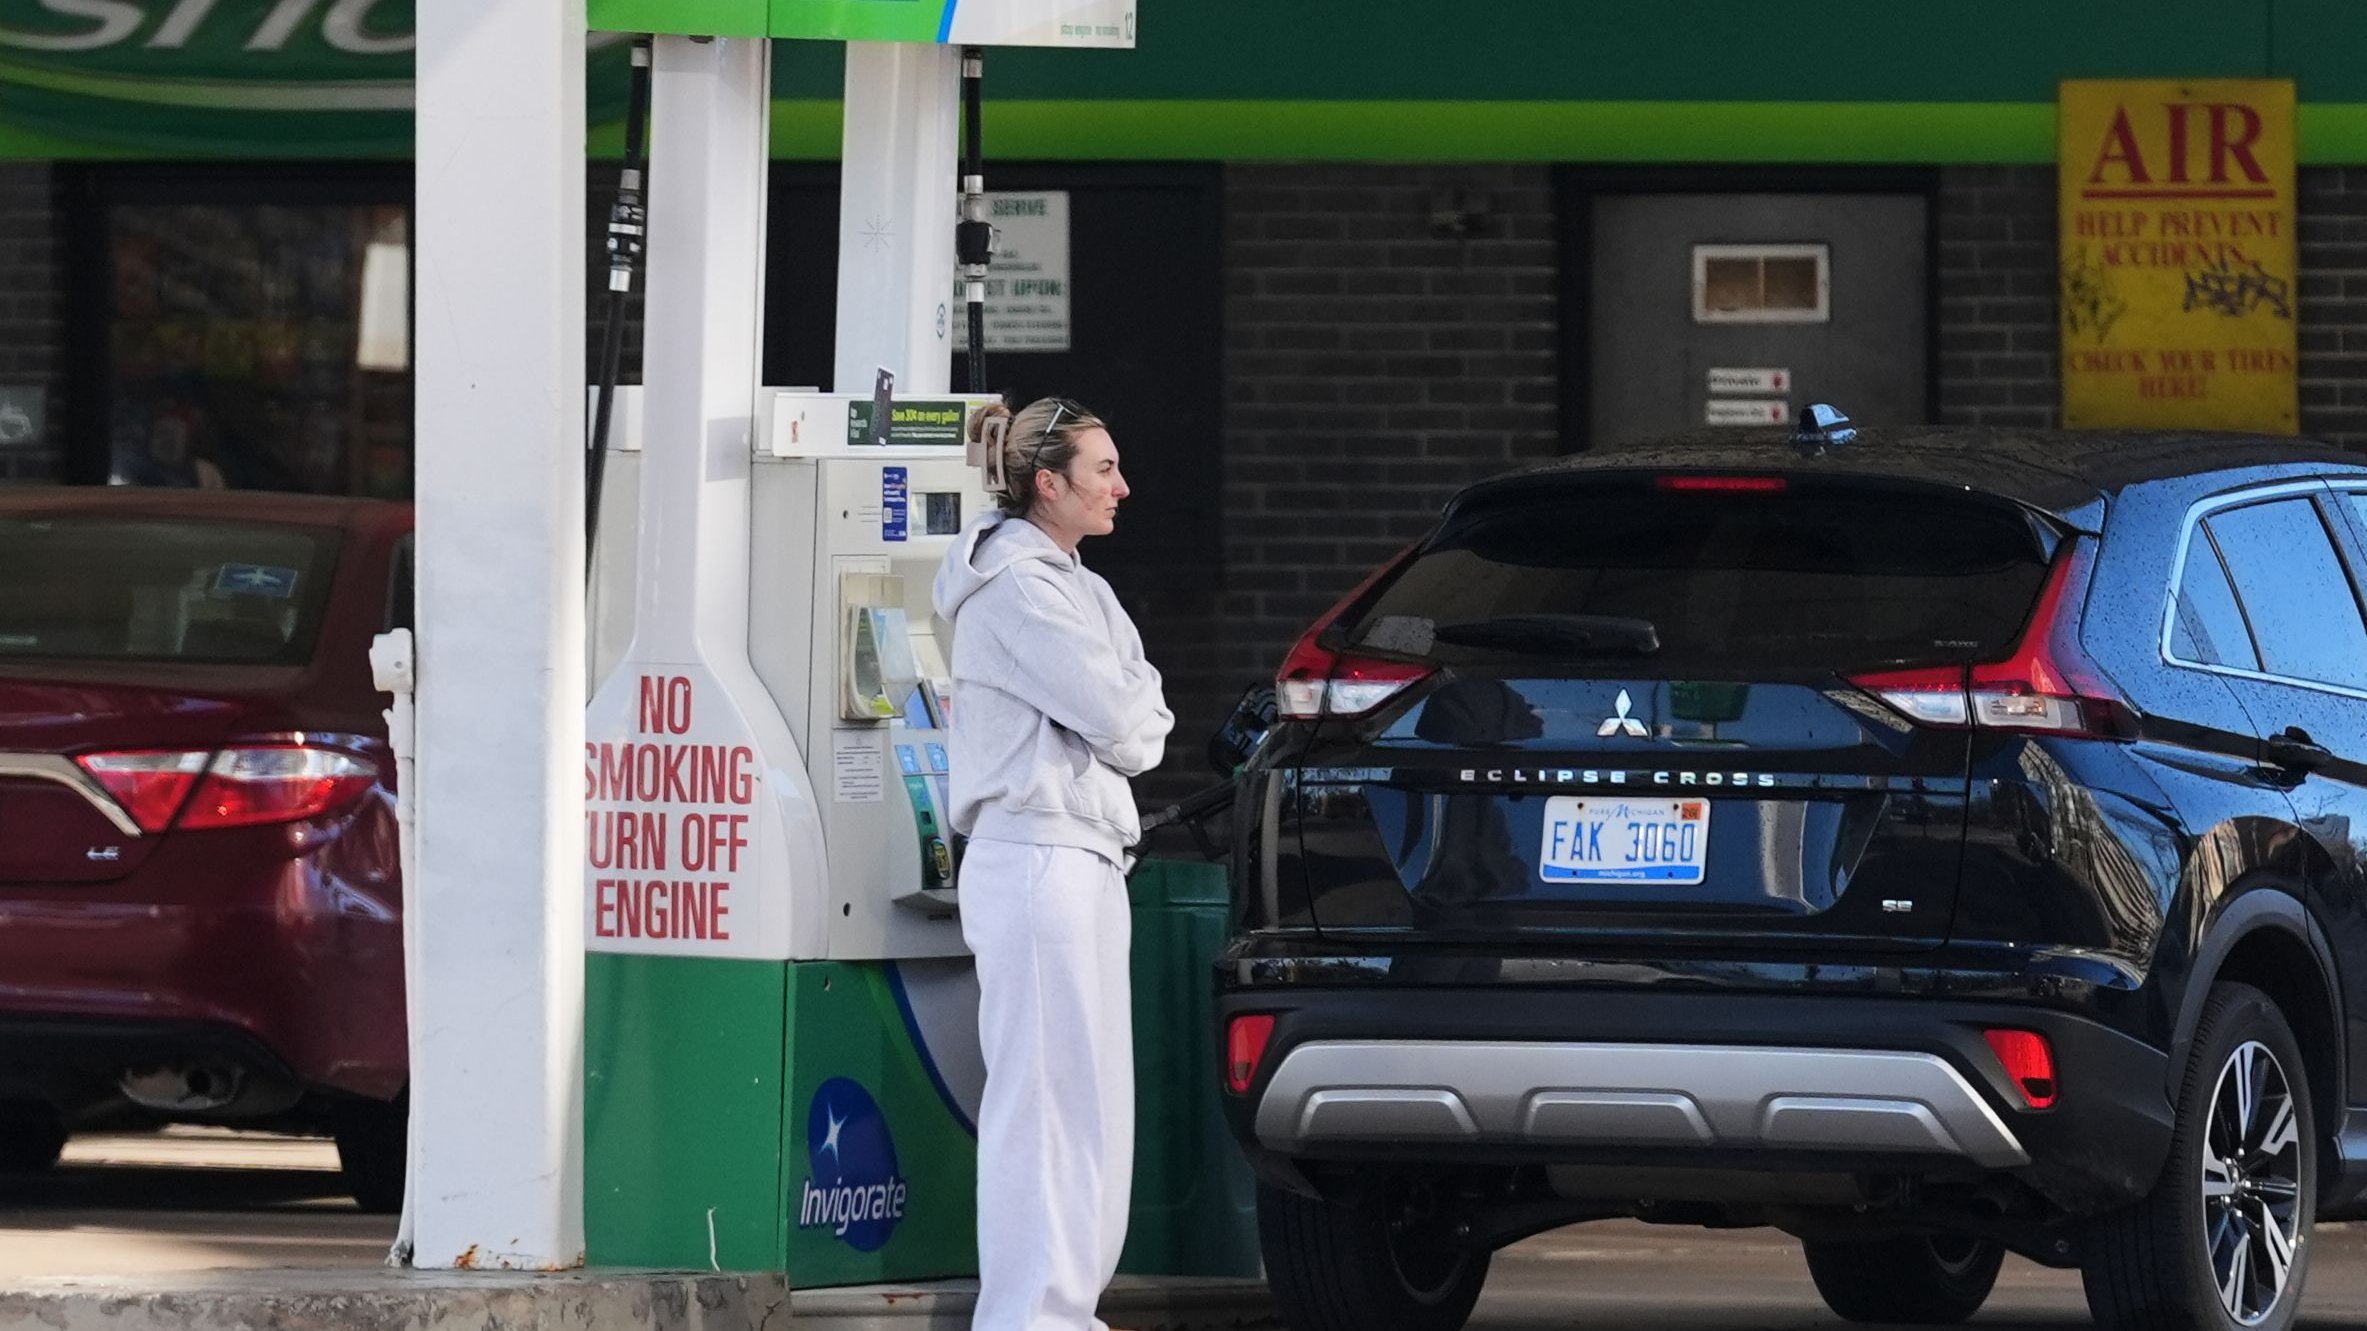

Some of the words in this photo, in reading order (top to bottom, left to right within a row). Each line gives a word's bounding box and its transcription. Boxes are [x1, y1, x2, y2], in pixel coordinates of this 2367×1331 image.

[2087, 102, 2270, 184] AIR
[2076, 211, 2148, 237] HELP
[2160, 211, 2282, 238] PREVENT
[2069, 350, 2145, 373] CHECK
[2159, 350, 2216, 372] YOUR
[2228, 349, 2292, 373] TIRES
[639, 675, 692, 735] NO
[585, 742, 753, 805] SMOKING
[1460, 769, 1626, 784] ECLIPSE
[1653, 771, 1775, 787] CROSS
[585, 811, 667, 871] URN
[681, 813, 749, 873] OFF
[1551, 821, 1604, 861] FAK
[1625, 822, 1695, 863] 3060
[596, 878, 730, 940] ENGINE
[1882, 899, 1913, 912] SE
[800, 1176, 906, 1236] Invigorate
